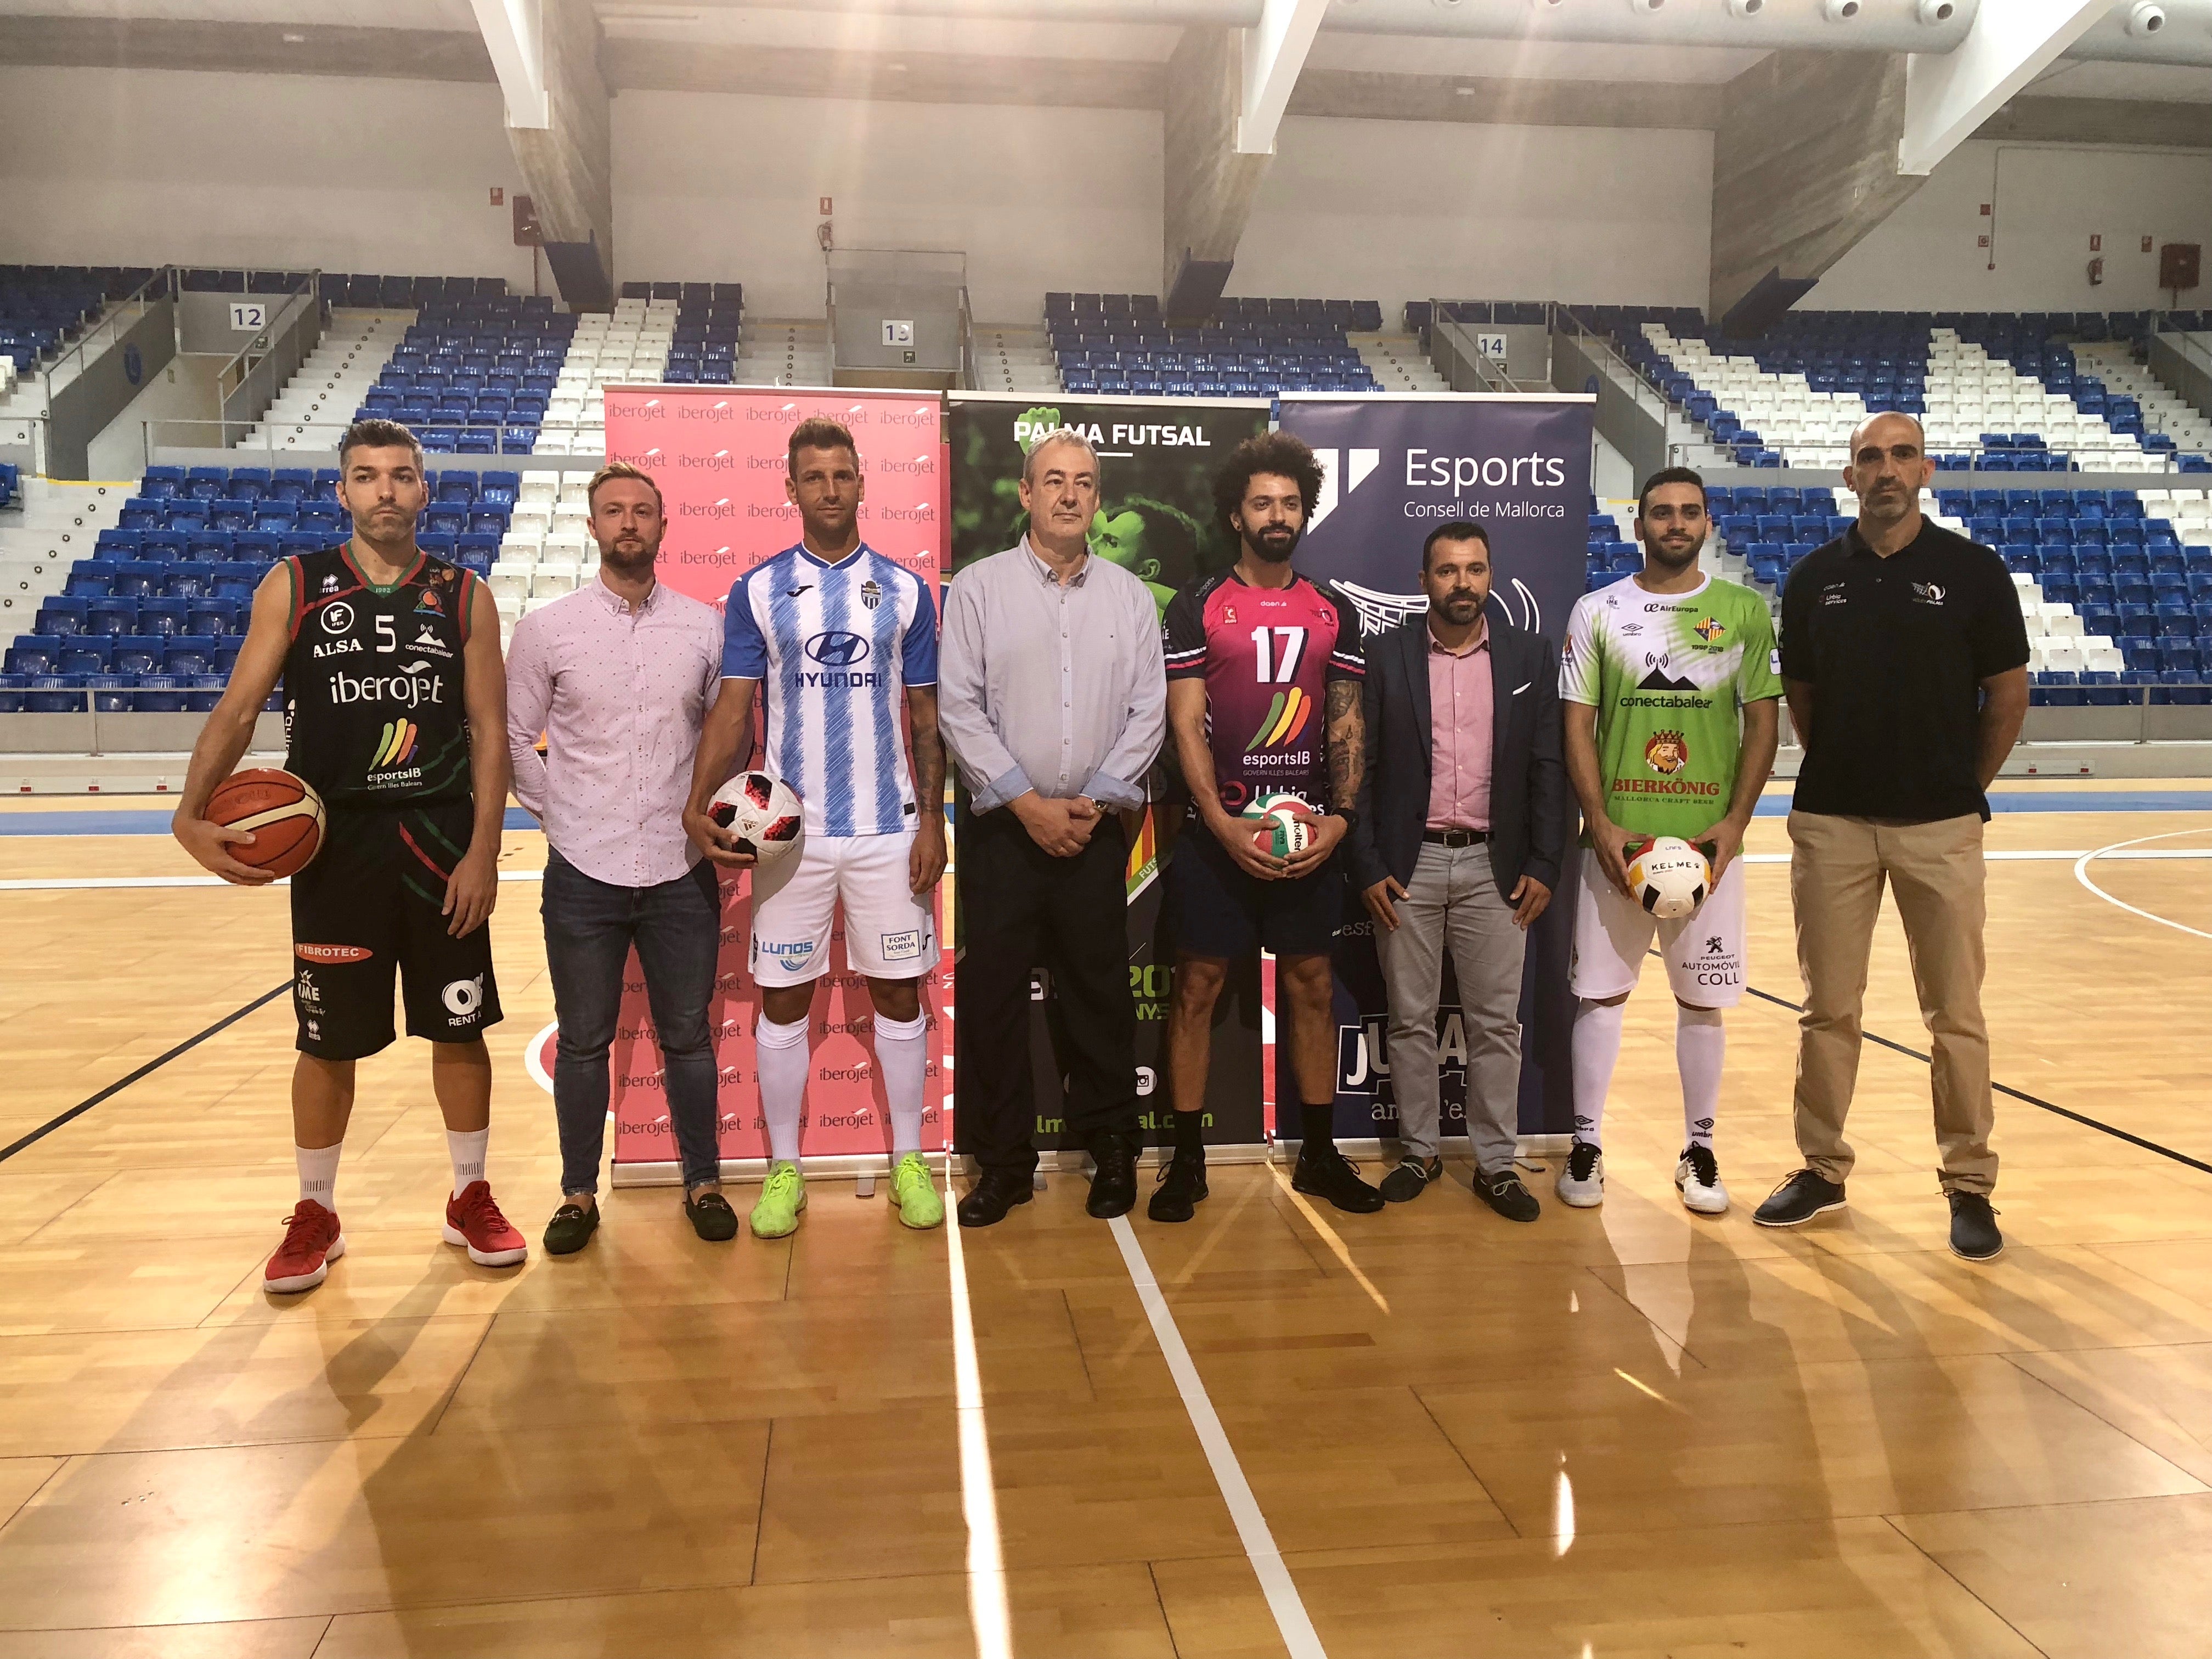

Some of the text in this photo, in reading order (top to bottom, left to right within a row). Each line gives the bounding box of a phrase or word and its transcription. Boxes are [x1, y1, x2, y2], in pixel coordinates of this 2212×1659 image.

[234, 308, 261, 326] 12
[885, 324, 910, 341] 13
[1481, 338, 1503, 354] 14
[609, 404, 666, 421] iberojet
[679, 405, 734, 423] iberojet
[746, 407, 801, 424] iberojet
[881, 411, 934, 428] iberojet
[1113, 424, 1210, 447] FUTSAL
[679, 454, 735, 471] iberojet
[881, 459, 935, 476] iberojet
[1406, 448, 1565, 497] Esports
[680, 502, 736, 520] iberojet
[882, 507, 935, 524] iberojet
[1404, 501, 1565, 517] Consell de Mallorca
[680, 550, 736, 568] iberojet
[375, 614, 397, 653] 5
[313, 638, 364, 658] ALSA
[405, 643, 454, 658] conectabalear
[1250, 625, 1308, 684] 17
[795, 672, 882, 688] HYUNDAI
[329, 671, 443, 709] iberojet
[1620, 695, 1713, 709] conectabalear
[1612, 777, 1720, 795] BIERKÖNIG
[1651, 862, 1692, 871] KELME
[886, 941, 916, 951] SORDA
[889, 934, 912, 944] FONT
[298, 945, 359, 957] FIBROTEC
[1697, 972, 1739, 985] COLL
[298, 983, 320, 1001] IME
[448, 1013, 476, 1026] RENT
[820, 1067, 873, 1083] iberojet
[820, 1113, 874, 1129] iberojet
